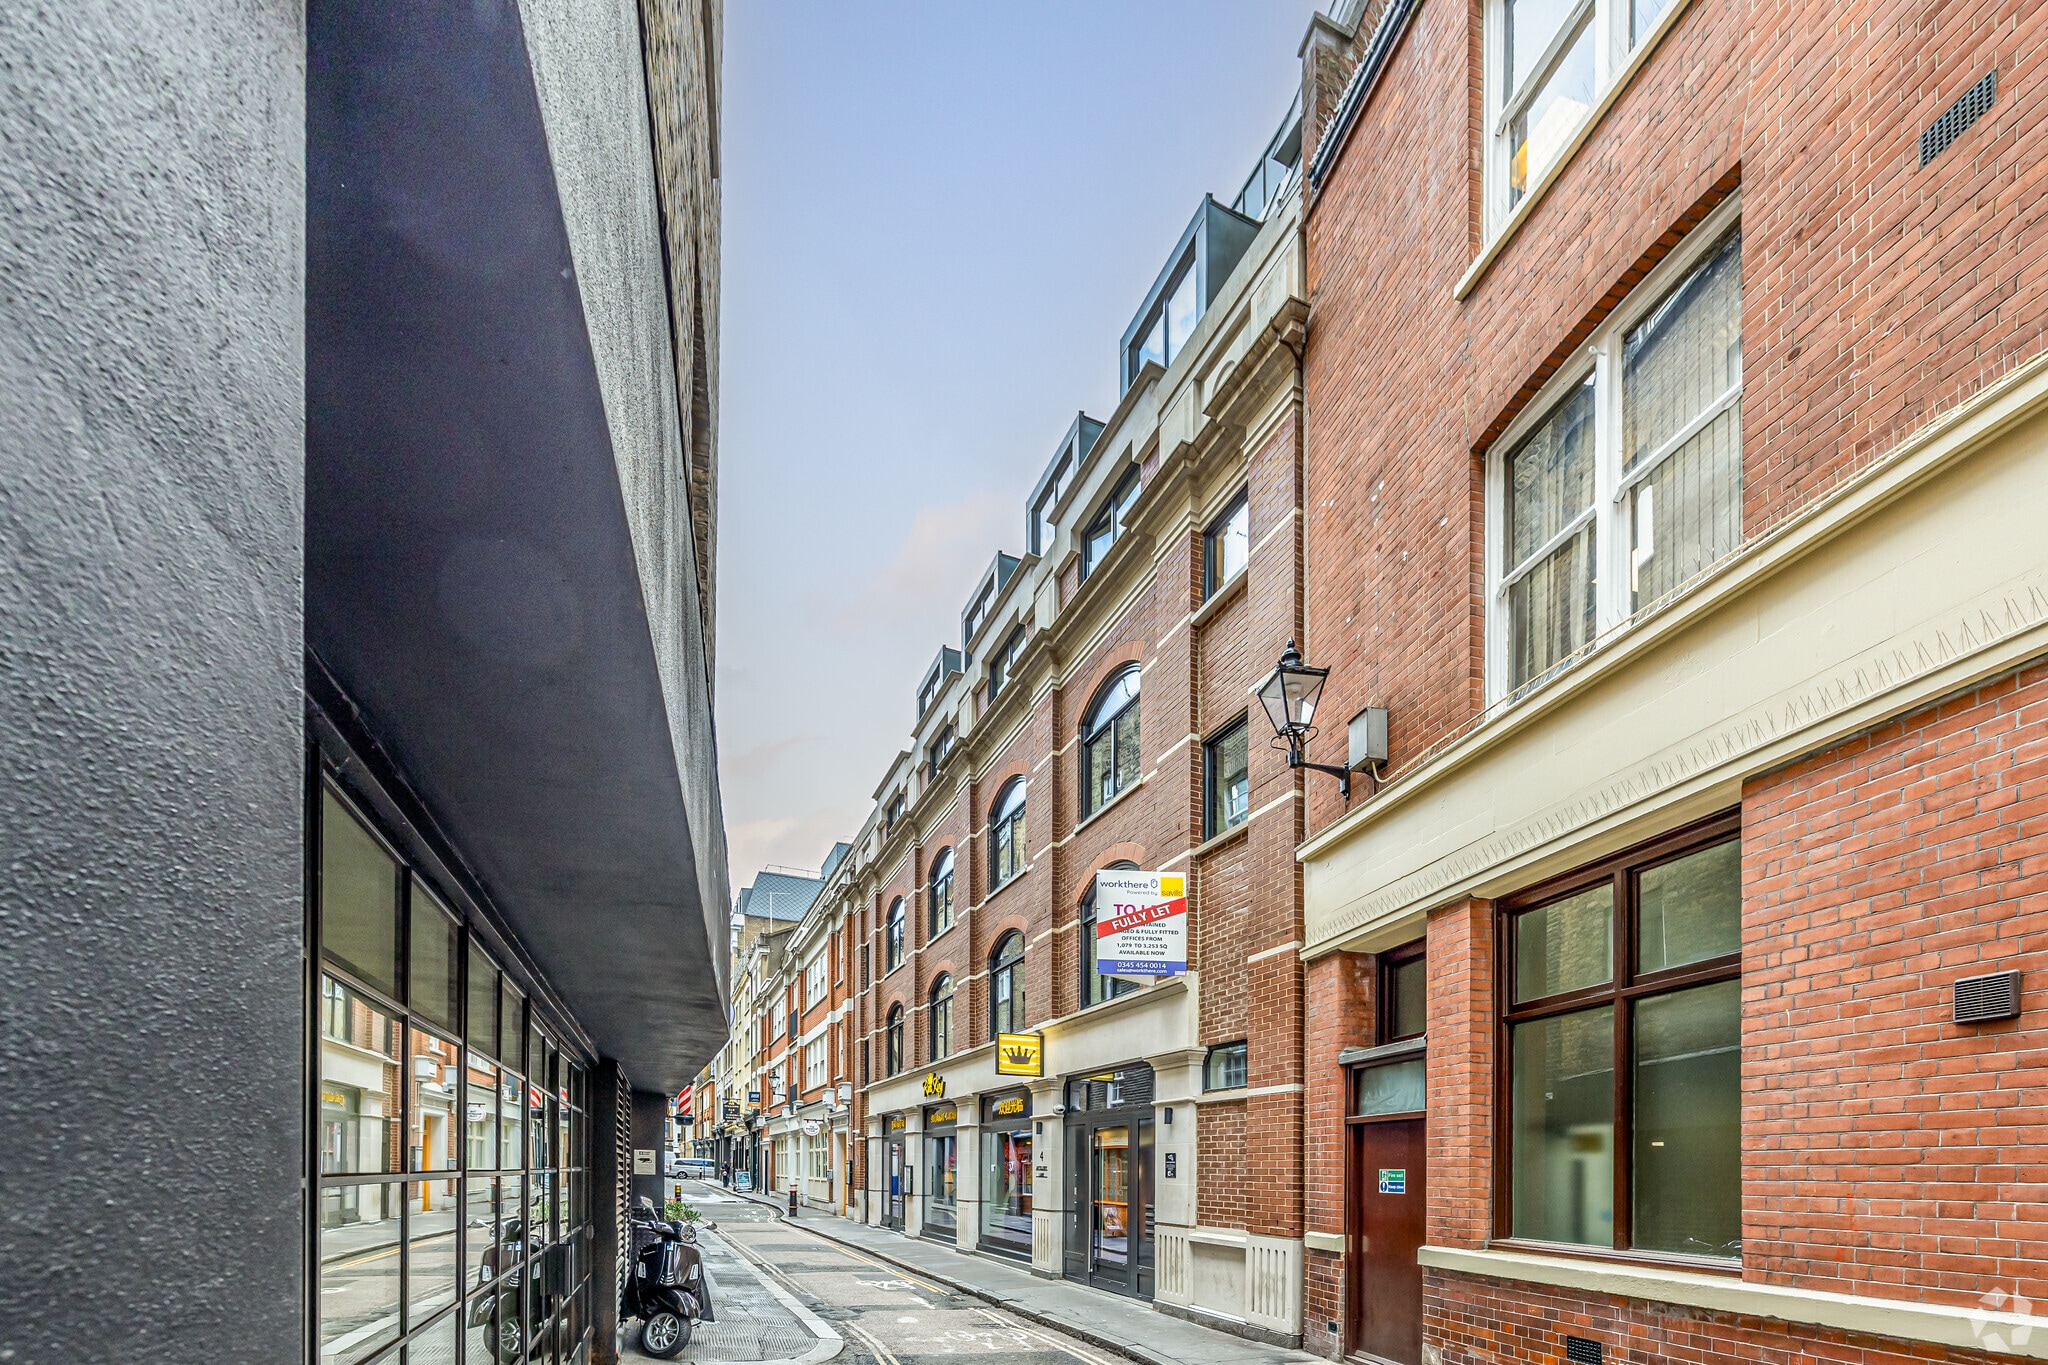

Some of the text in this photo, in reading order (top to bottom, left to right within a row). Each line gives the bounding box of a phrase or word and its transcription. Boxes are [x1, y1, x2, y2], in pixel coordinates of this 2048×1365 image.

[1100, 880, 1149, 889] workthere
[1161, 889, 1183, 897] savills
[1113, 904, 1136, 916] TO
[1111, 905, 1171, 930] FULLY LET
[1040, 1151, 1044, 1161] 4
